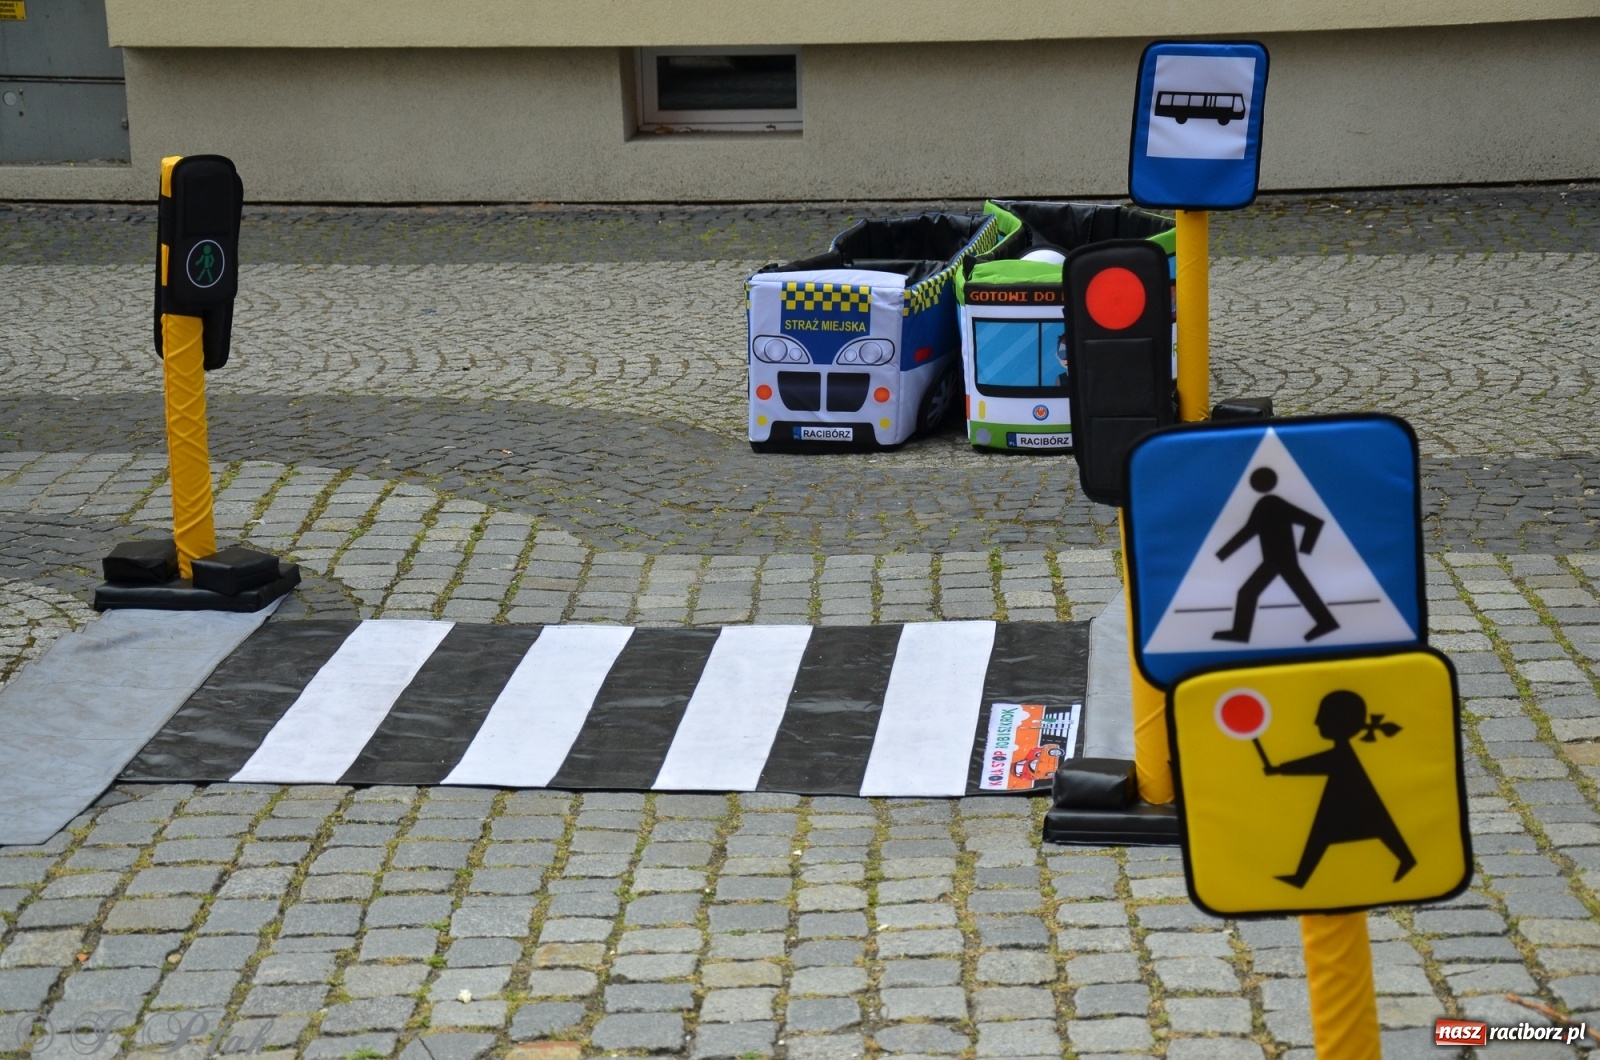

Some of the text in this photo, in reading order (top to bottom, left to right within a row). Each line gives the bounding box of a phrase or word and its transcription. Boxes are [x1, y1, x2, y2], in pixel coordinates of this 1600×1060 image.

[970, 291, 1028, 302] GOTOWI
[1034, 291, 1055, 302] DO
[785, 317, 866, 333] STRAŻ MIEJSKA
[803, 429, 851, 439] RACIBÓRZ
[1020, 436, 1069, 446] RACIBÓRZ
